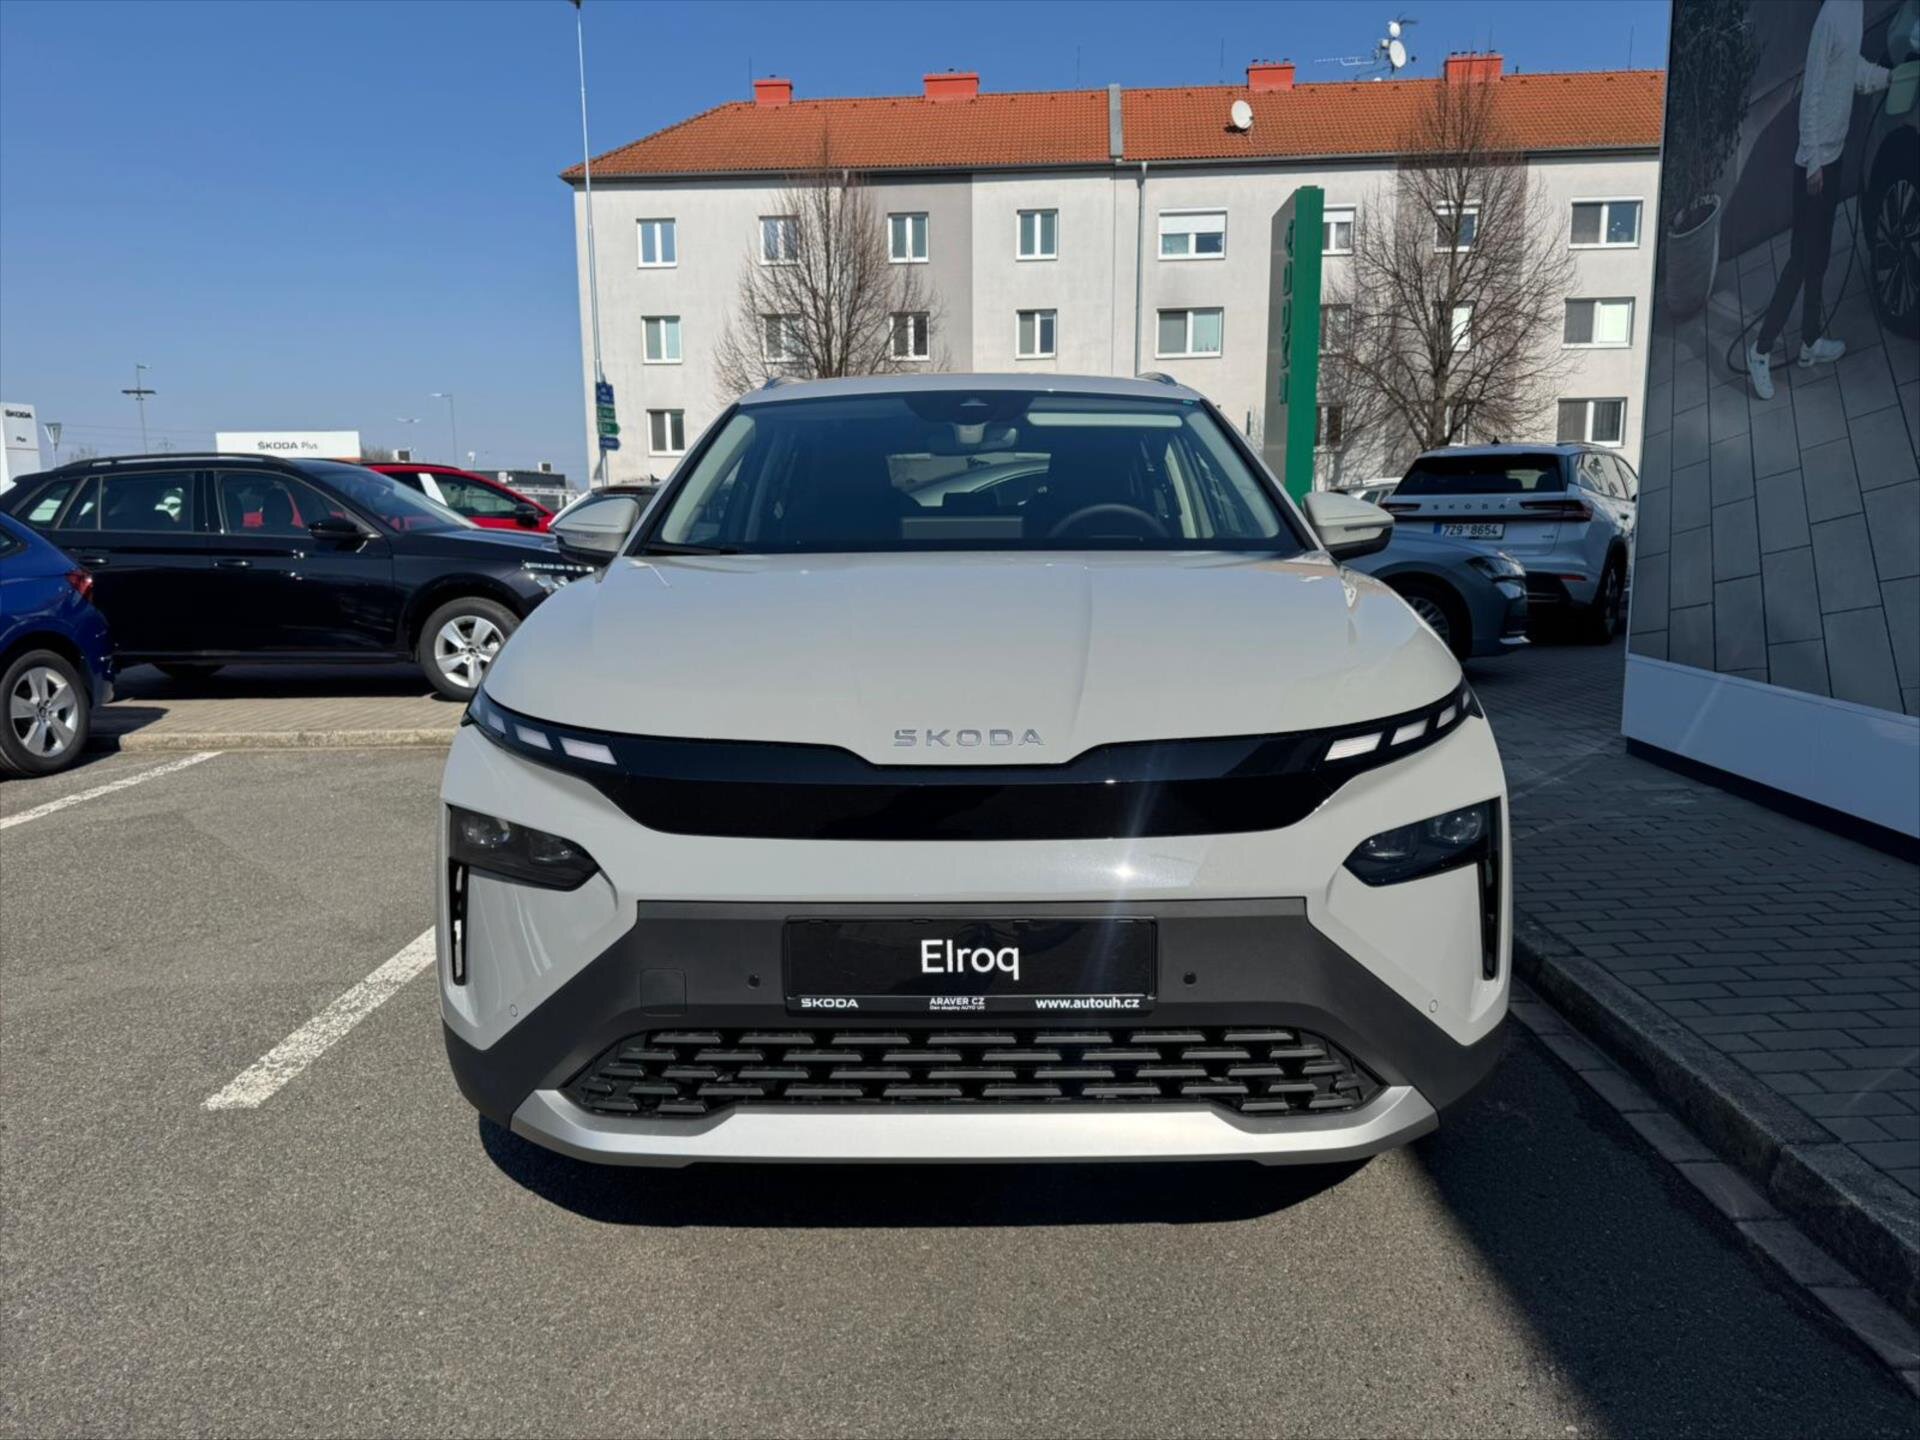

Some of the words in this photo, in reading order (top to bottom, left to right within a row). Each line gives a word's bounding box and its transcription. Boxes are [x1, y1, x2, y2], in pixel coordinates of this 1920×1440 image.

[301, 441, 318, 449] Plus
[1443, 524, 1463, 536] 7Z9
[1470, 524, 1498, 536] 8654
[921, 939, 1019, 980] Elroq
[930, 997, 969, 1005] ARAVER
[971, 997, 985, 1005] CZ
[1036, 996, 1139, 1009] www.autouh.cz
